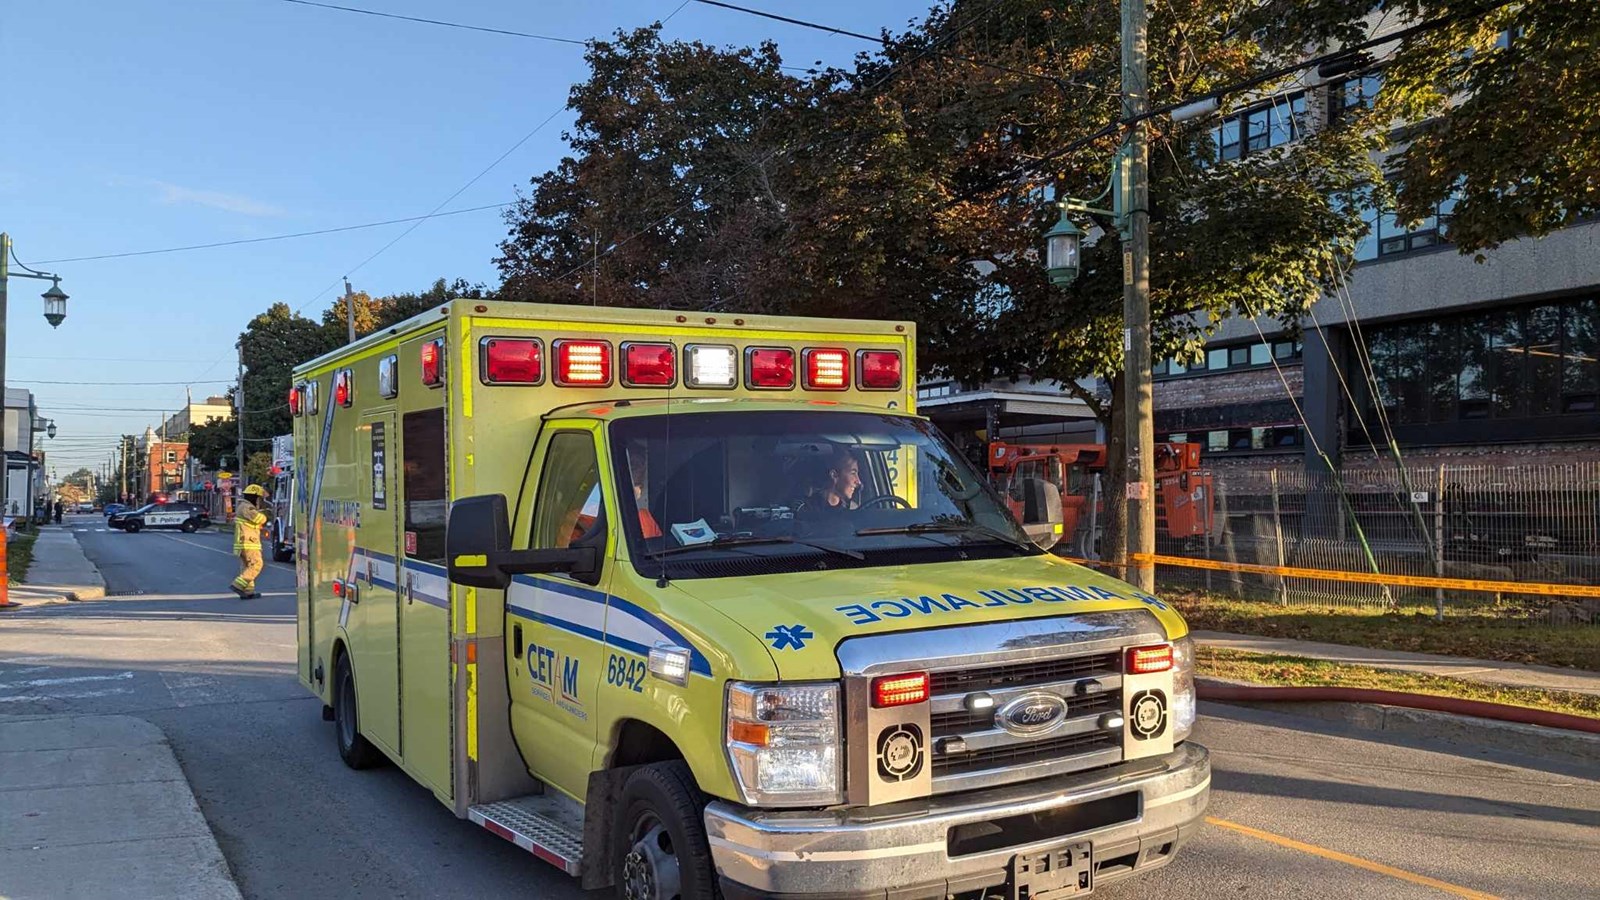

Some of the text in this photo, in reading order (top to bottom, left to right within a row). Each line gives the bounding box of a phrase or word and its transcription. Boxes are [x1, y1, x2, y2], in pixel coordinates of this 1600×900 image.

[159, 516, 181, 524] Police
[527, 643, 580, 700] CETAM
[607, 654, 647, 693] 6842
[1021, 704, 1053, 723] Ford
